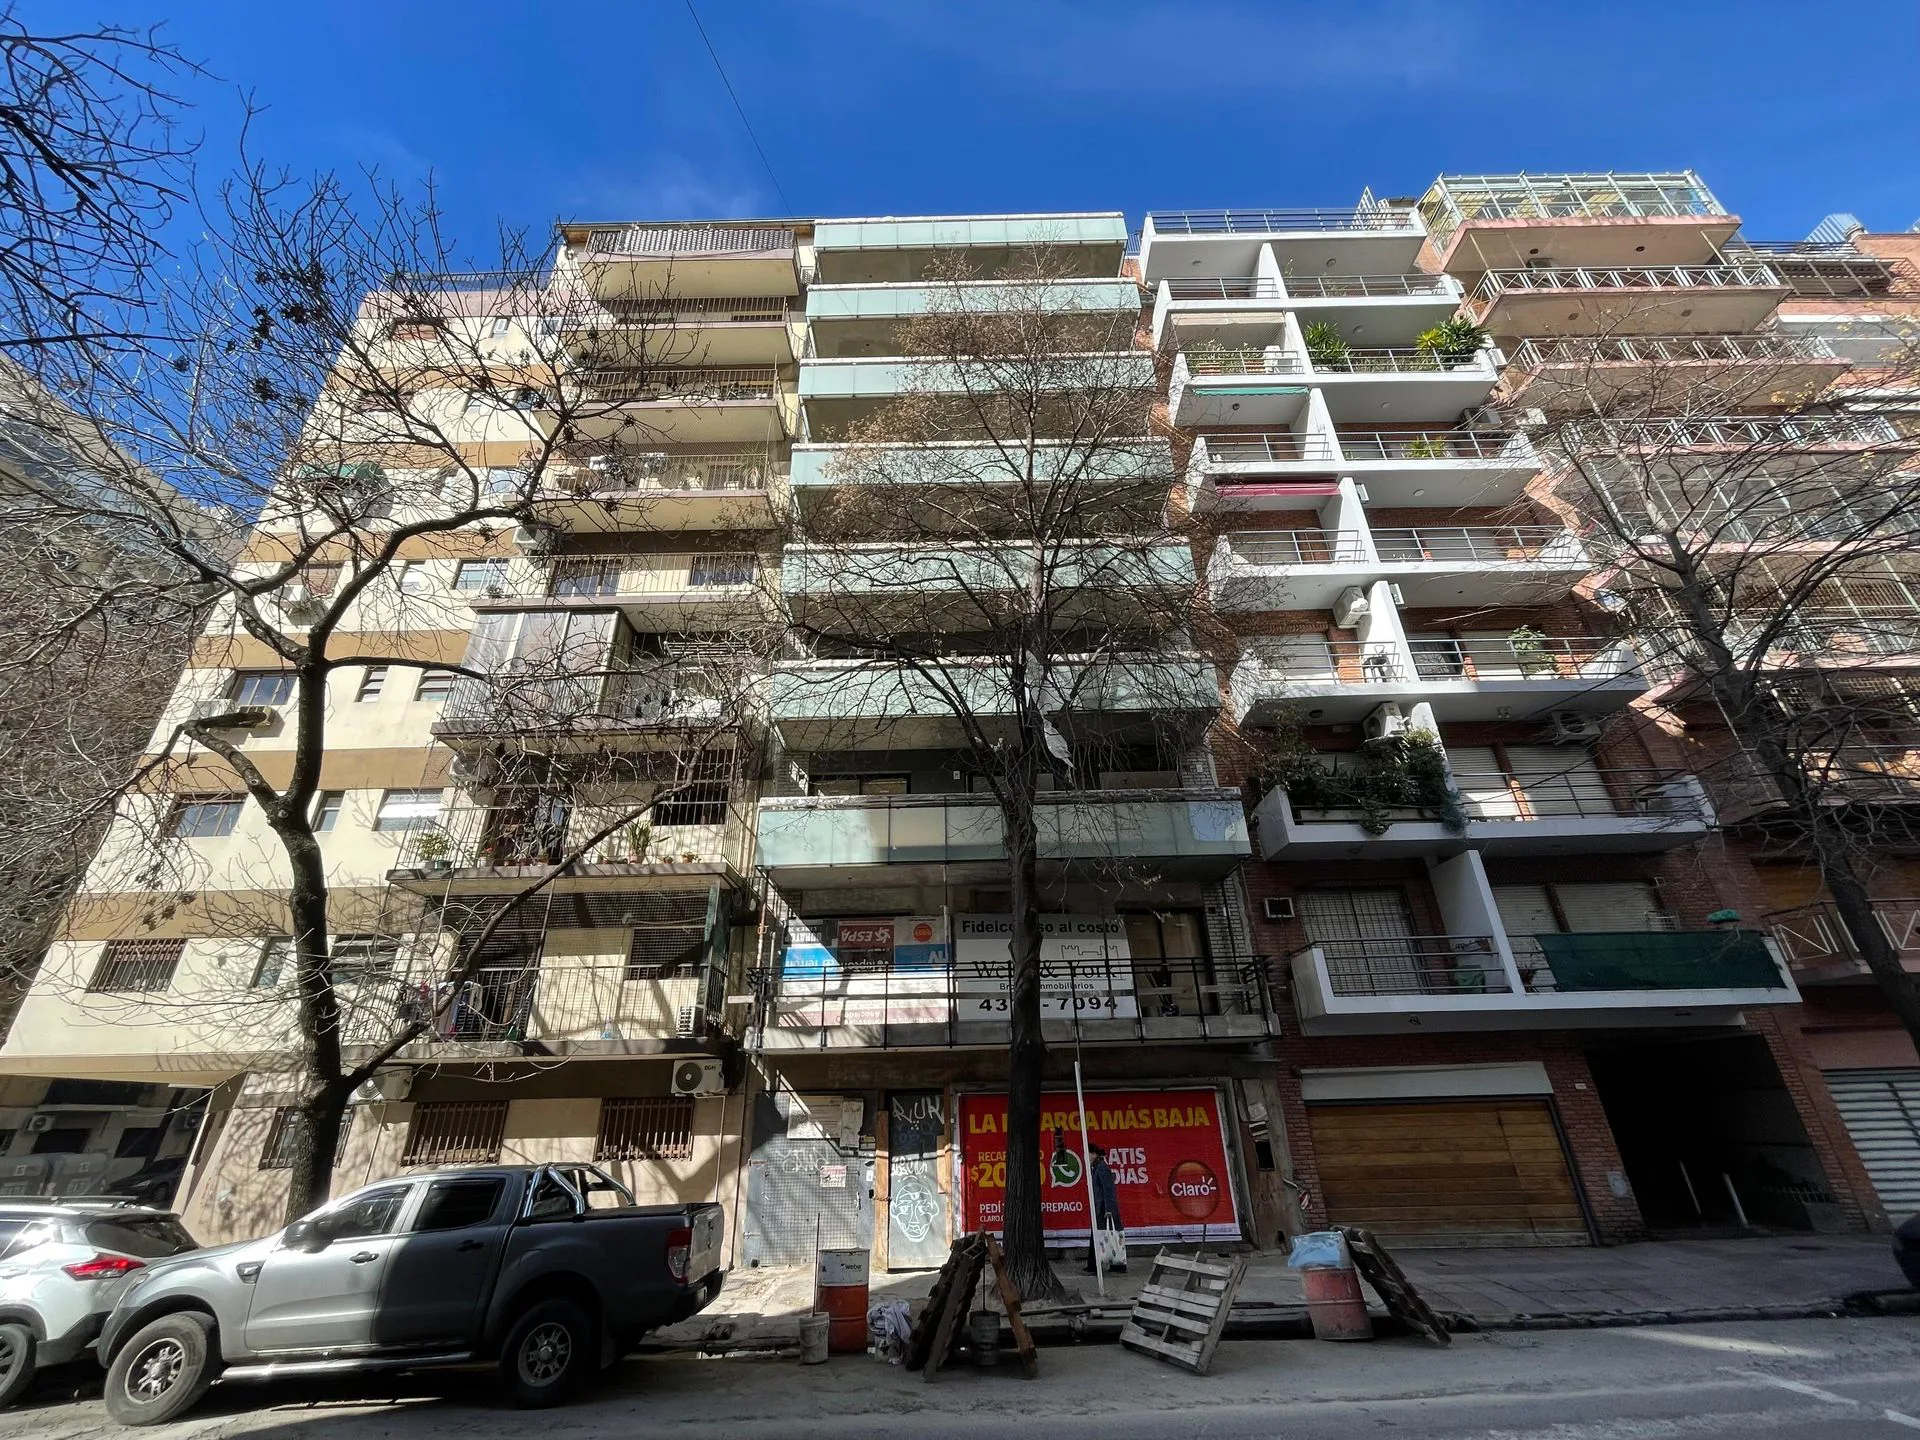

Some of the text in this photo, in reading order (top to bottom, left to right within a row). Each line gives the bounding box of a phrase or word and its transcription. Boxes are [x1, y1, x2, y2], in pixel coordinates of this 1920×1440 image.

[963, 920, 1119, 933] Fideicoso al costo
[969, 1113, 998, 1134] LA
[1102, 1104, 1151, 1130] MÁS
[1153, 1106, 1211, 1129] BAJA
[1171, 1179, 1212, 1197] Claro
[980, 1200, 1083, 1214] PEDÍ PREPAGO
